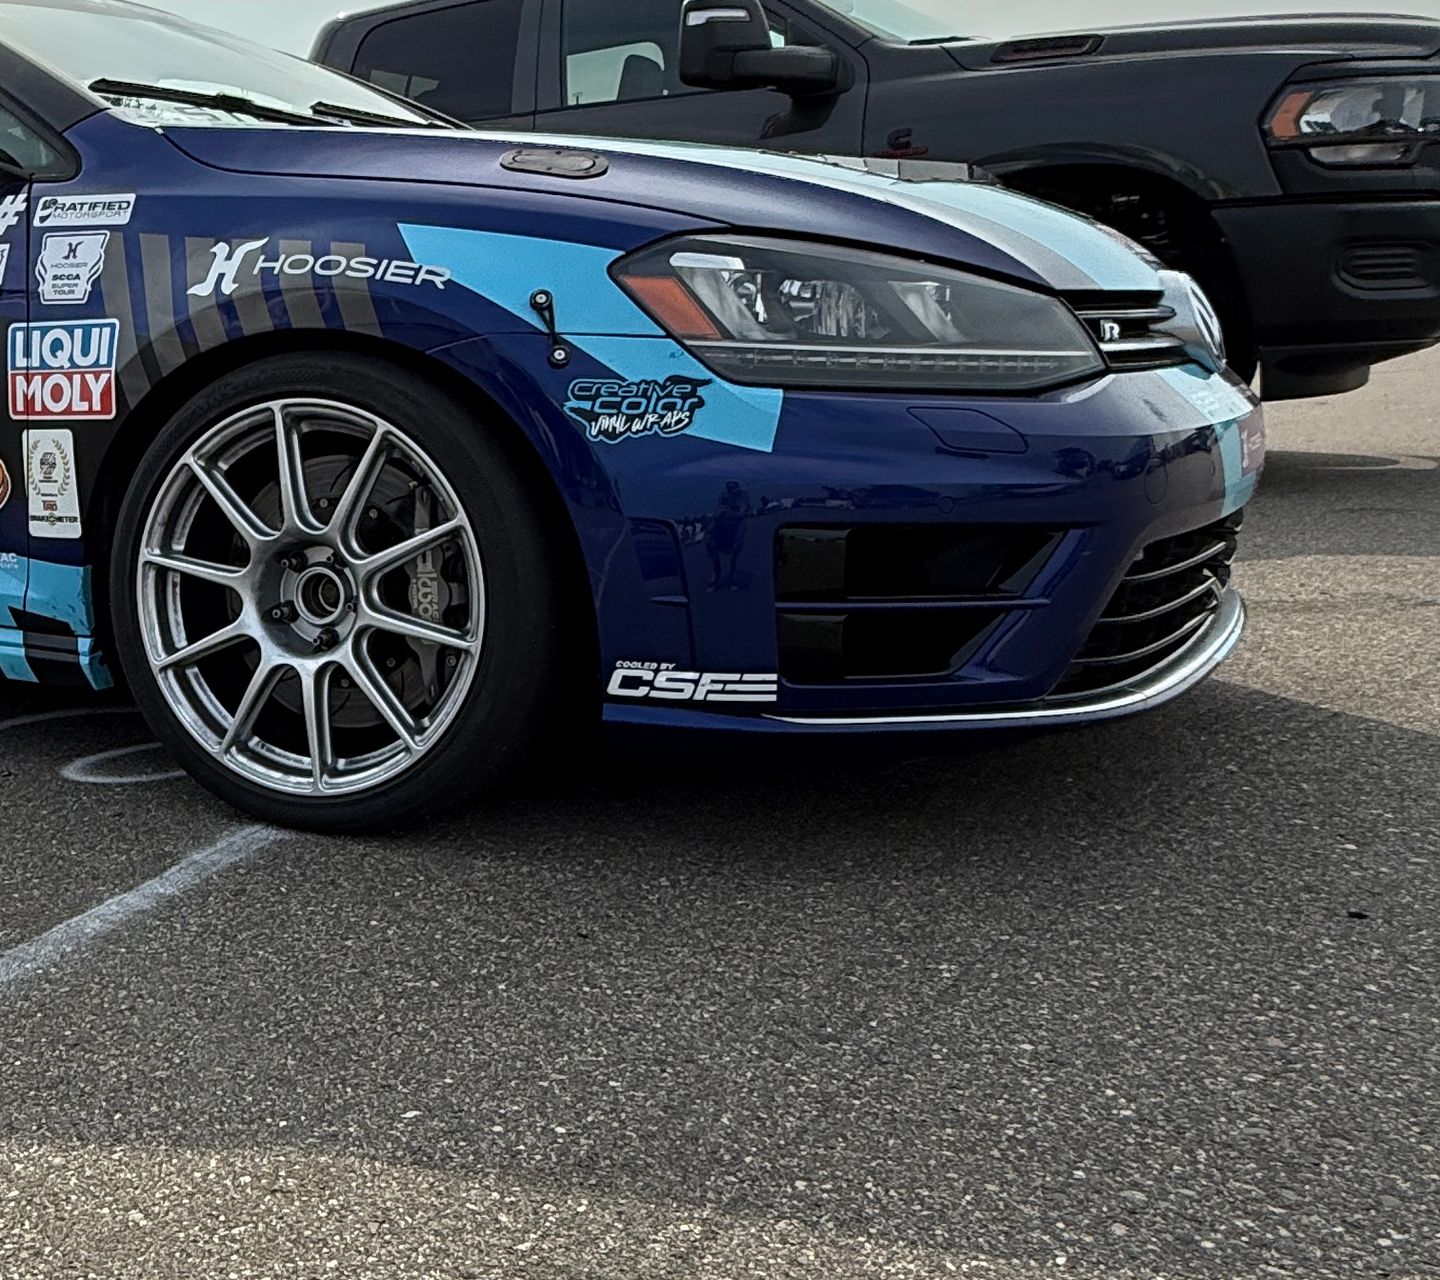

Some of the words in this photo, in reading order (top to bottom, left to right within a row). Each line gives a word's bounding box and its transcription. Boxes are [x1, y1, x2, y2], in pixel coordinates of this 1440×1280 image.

[51, 273, 81, 281] SCCA
[252, 253, 452, 290] HOOSIER
[15, 327, 112, 370] LIQUI
[15, 373, 111, 414] MOLY
[616, 660, 658, 671] COOLED
[660, 663, 677, 671] BY
[606, 668, 778, 702] CSF
